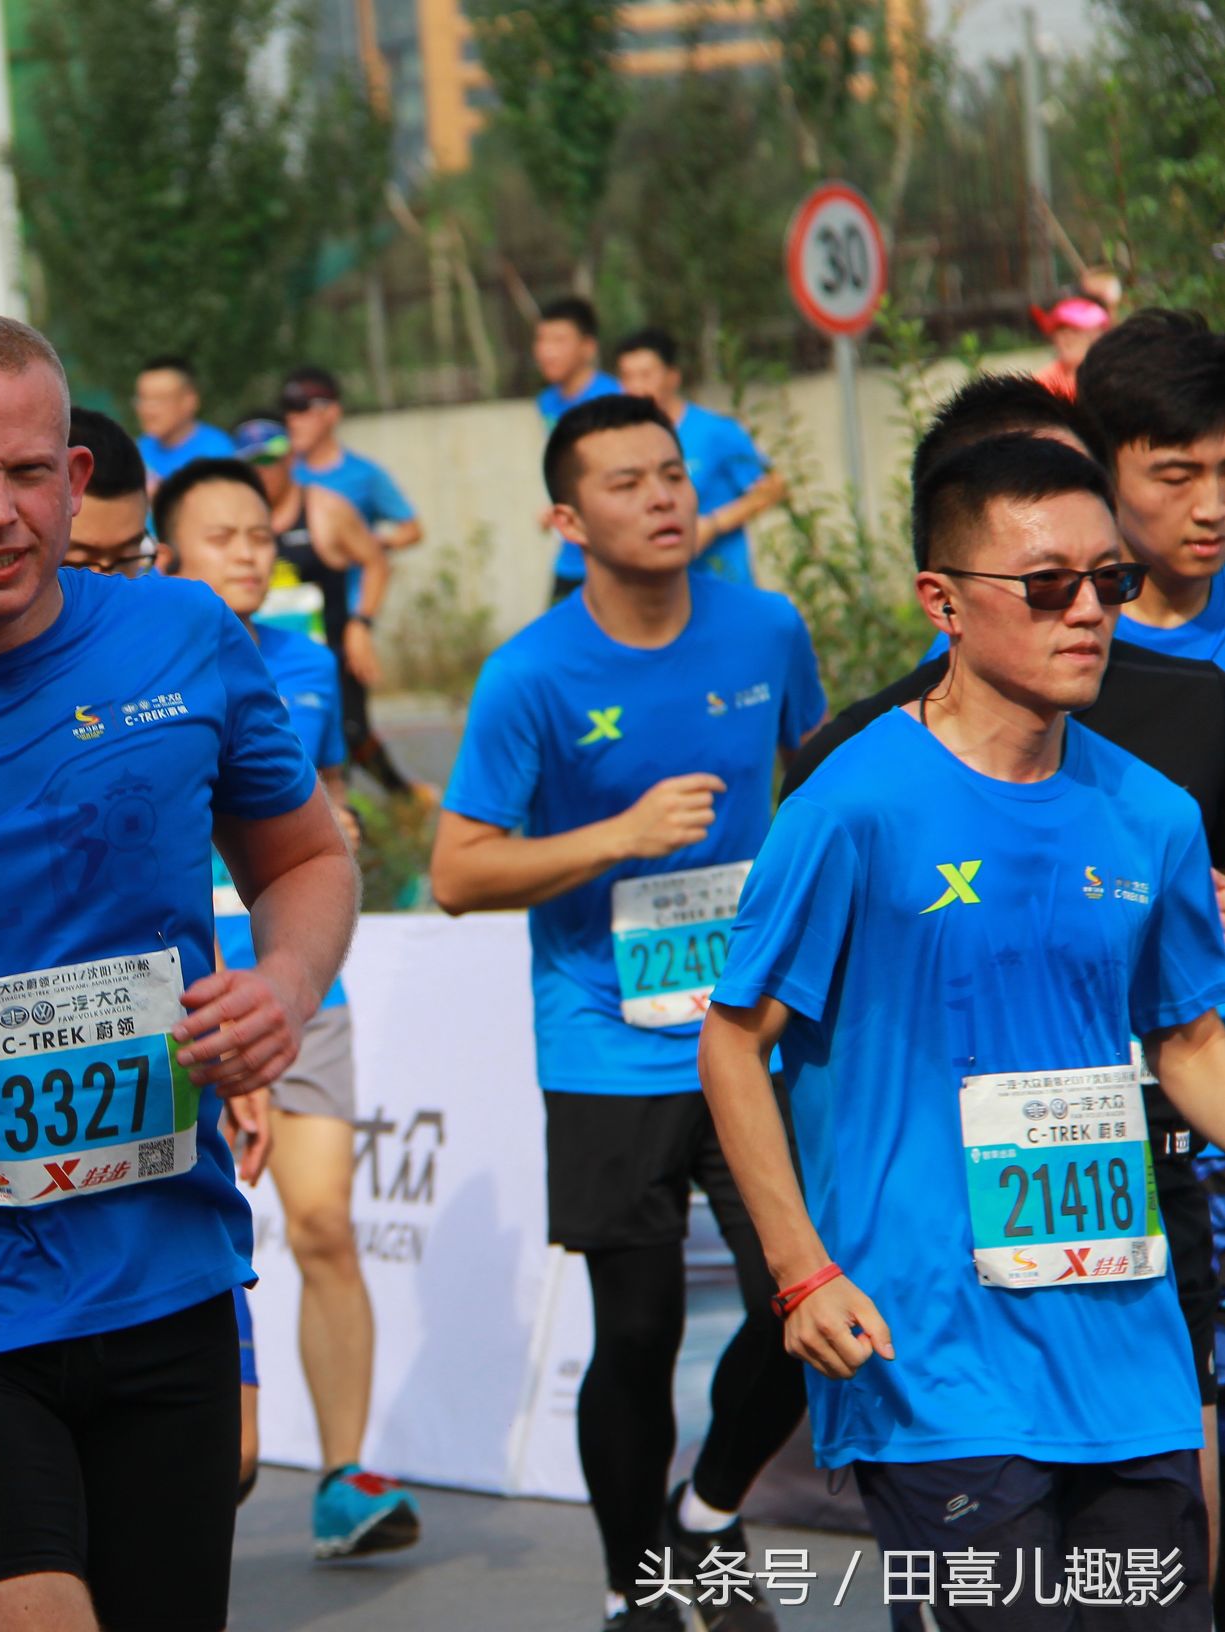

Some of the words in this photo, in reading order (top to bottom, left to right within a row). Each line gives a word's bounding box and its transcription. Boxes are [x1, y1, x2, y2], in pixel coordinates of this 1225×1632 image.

[817, 222, 869, 294] 30
[2, 1025, 86, 1054] C-TREK
[96, 1016, 135, 1040] 蔚领
[1028, 1124, 1091, 1143] C-TREK
[999, 1158, 1133, 1238] 21418
